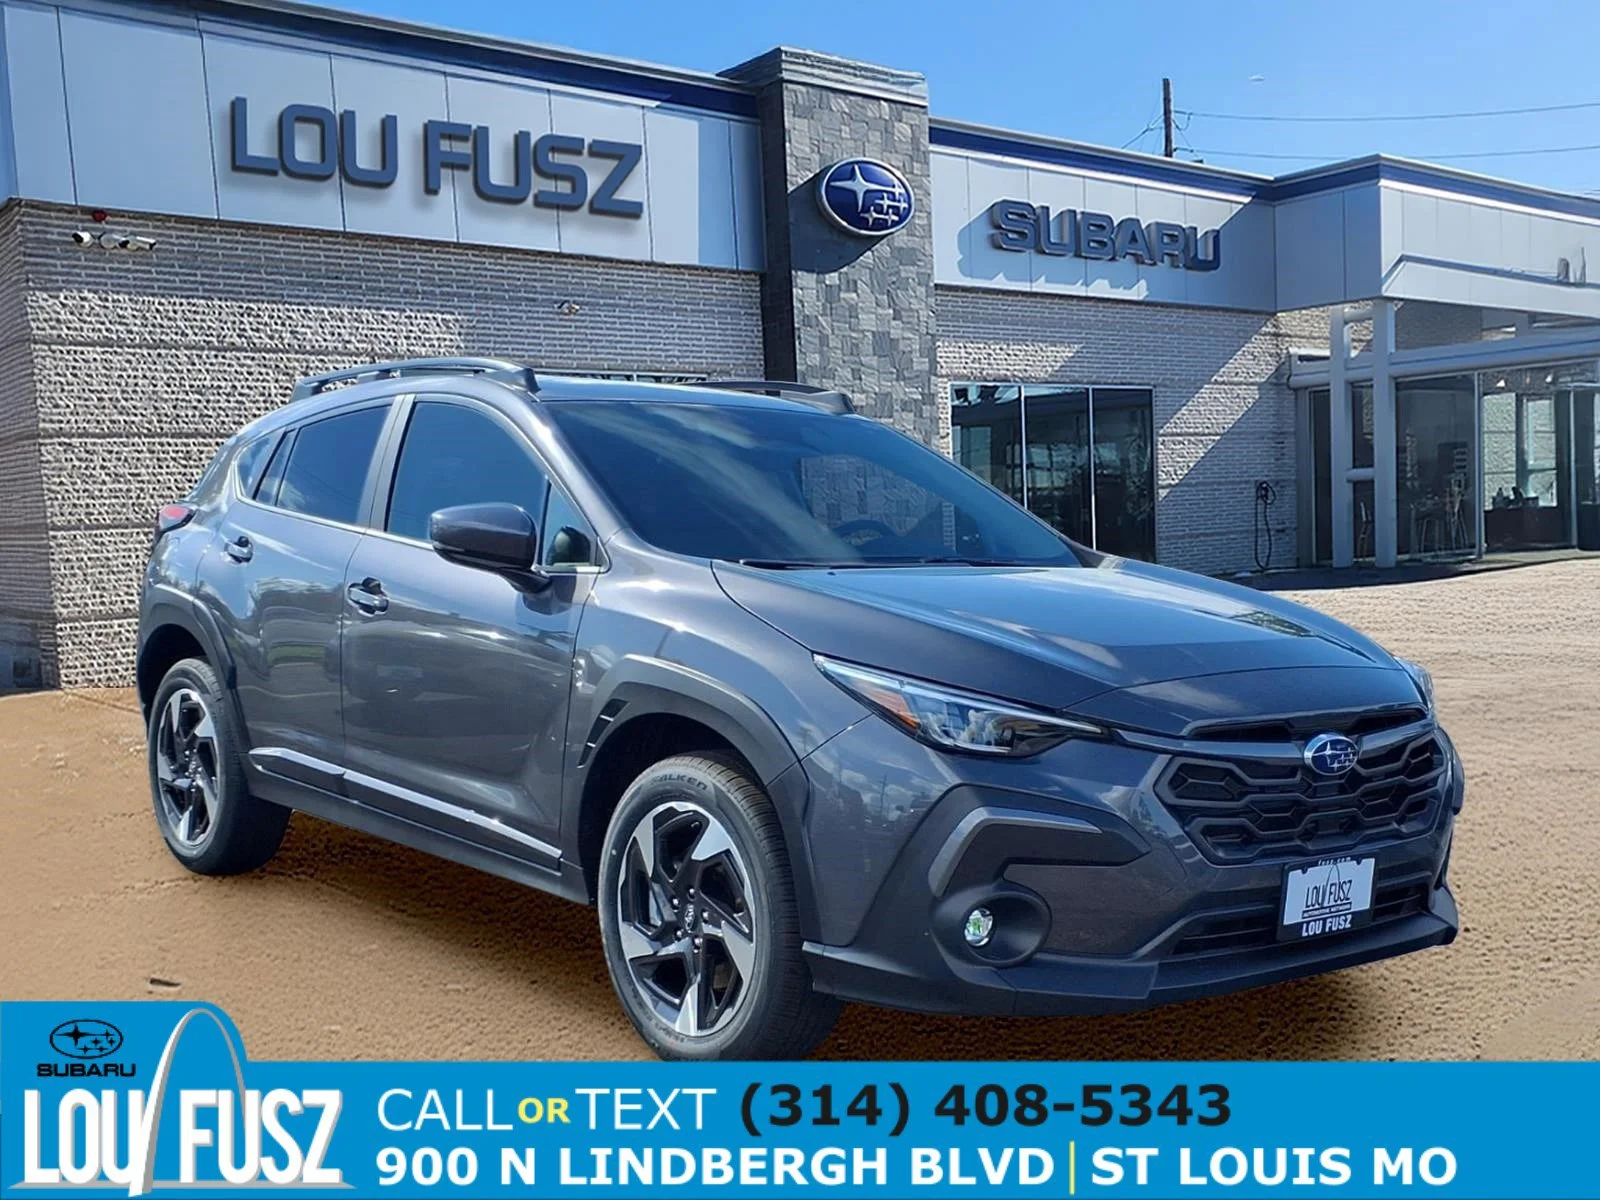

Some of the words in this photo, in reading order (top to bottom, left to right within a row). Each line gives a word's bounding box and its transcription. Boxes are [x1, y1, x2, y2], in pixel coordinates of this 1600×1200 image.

[231, 96, 398, 188] LOU
[424, 119, 643, 218] FUSZ
[992, 199, 1221, 271] SUBARU
[1305, 884, 1328, 908] LOU
[1327, 880, 1353, 905] FUSZ
[1302, 919, 1323, 937] LOU
[1325, 914, 1352, 932] FUSZ
